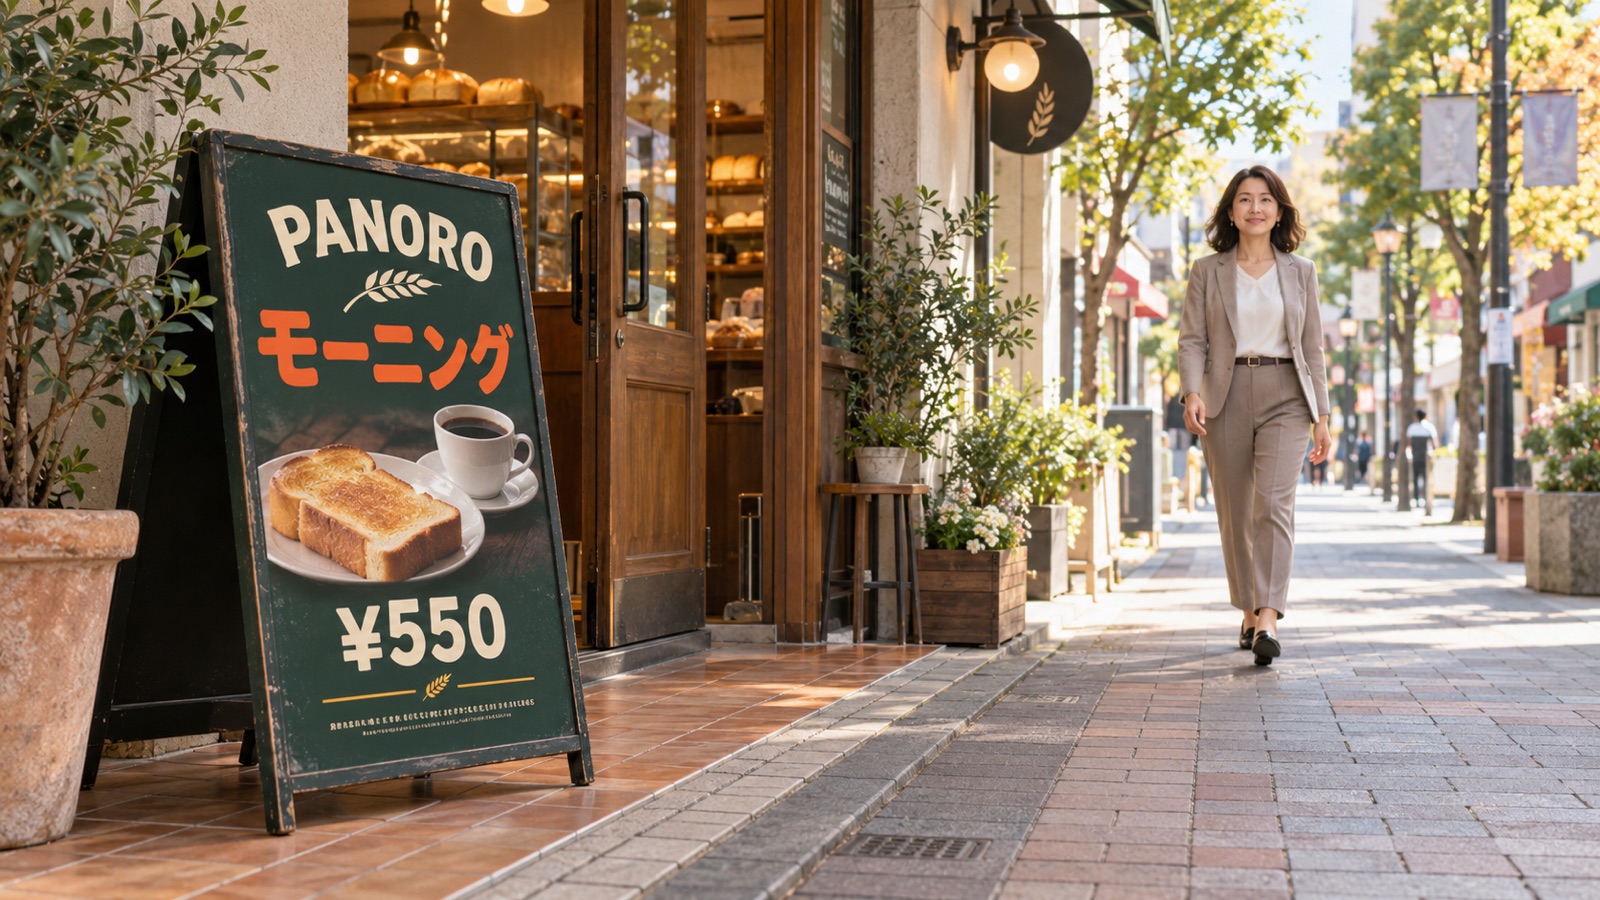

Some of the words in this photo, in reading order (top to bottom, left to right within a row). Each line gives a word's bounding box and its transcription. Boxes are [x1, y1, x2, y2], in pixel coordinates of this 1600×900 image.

[267, 198, 493, 282] PANORO
[257, 309, 514, 395] モーニング
[335, 593, 506, 672] ¥550
